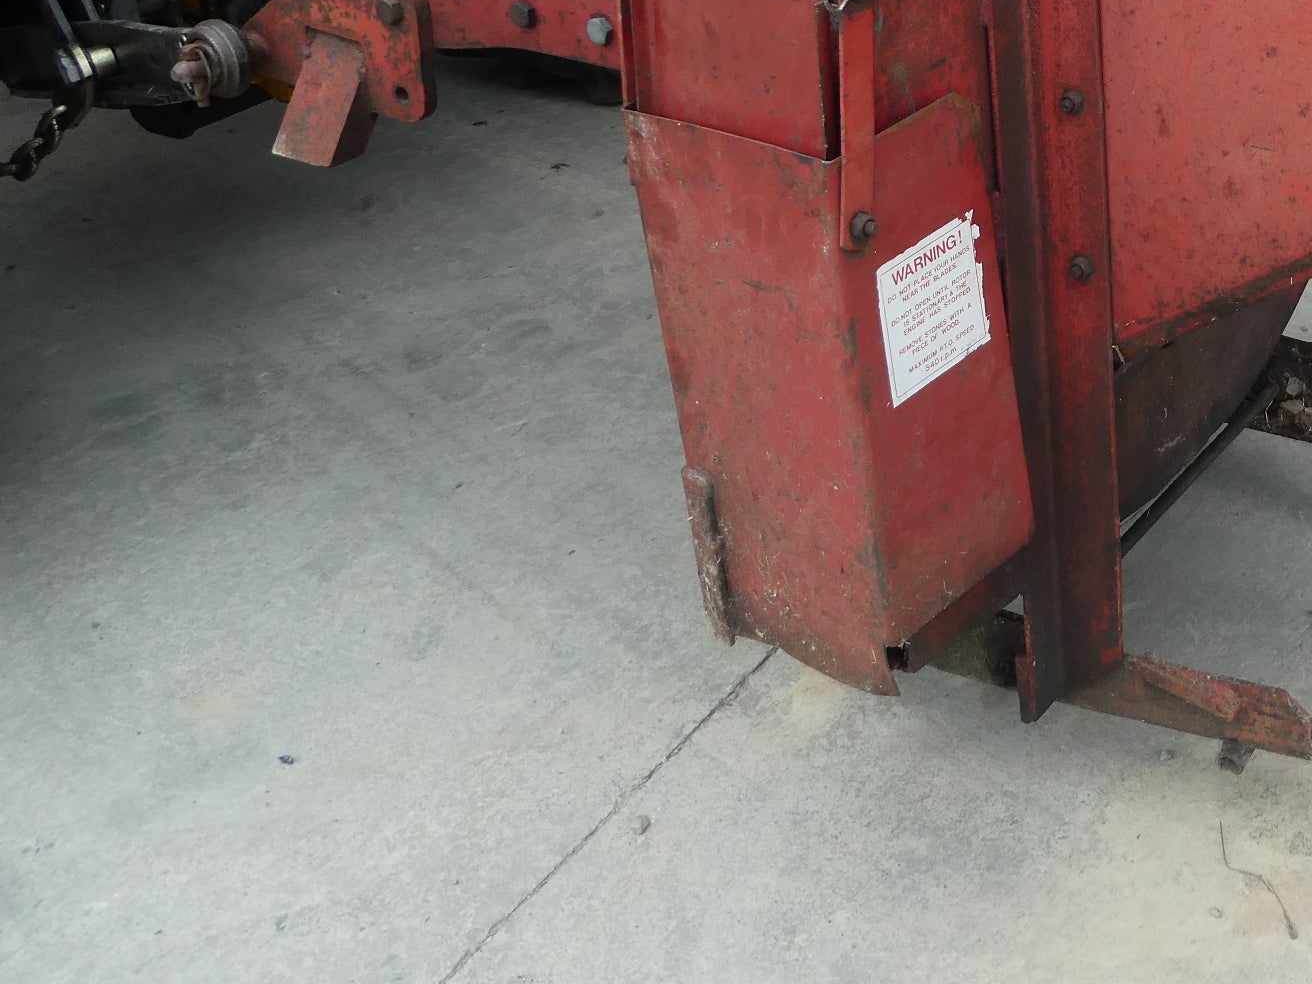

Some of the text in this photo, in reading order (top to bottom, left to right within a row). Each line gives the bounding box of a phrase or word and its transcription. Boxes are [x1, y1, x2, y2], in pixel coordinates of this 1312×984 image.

[887, 245, 970, 304] DO NOT PLACE YOUR HANDS
[891, 229, 963, 285] WARNING!
[891, 269, 971, 327] DO NOT OPEN UNTIL ROTOR
[902, 289, 919, 303] NEAR
[919, 279, 932, 291] THE
[912, 294, 948, 322] STATIONARY
[956, 280, 968, 292] THE
[898, 336, 923, 356] REMOVE
[924, 318, 948, 337] STONES
[949, 306, 965, 321] WITH
[903, 316, 926, 336] ENGINE
[929, 306, 942, 319] HAS
[908, 348, 938, 374] MAXIMUM
[955, 324, 975, 341] SPEED
[911, 341, 929, 356] PIECE
[930, 333, 938, 343] OF
[924, 357, 940, 372] 540
